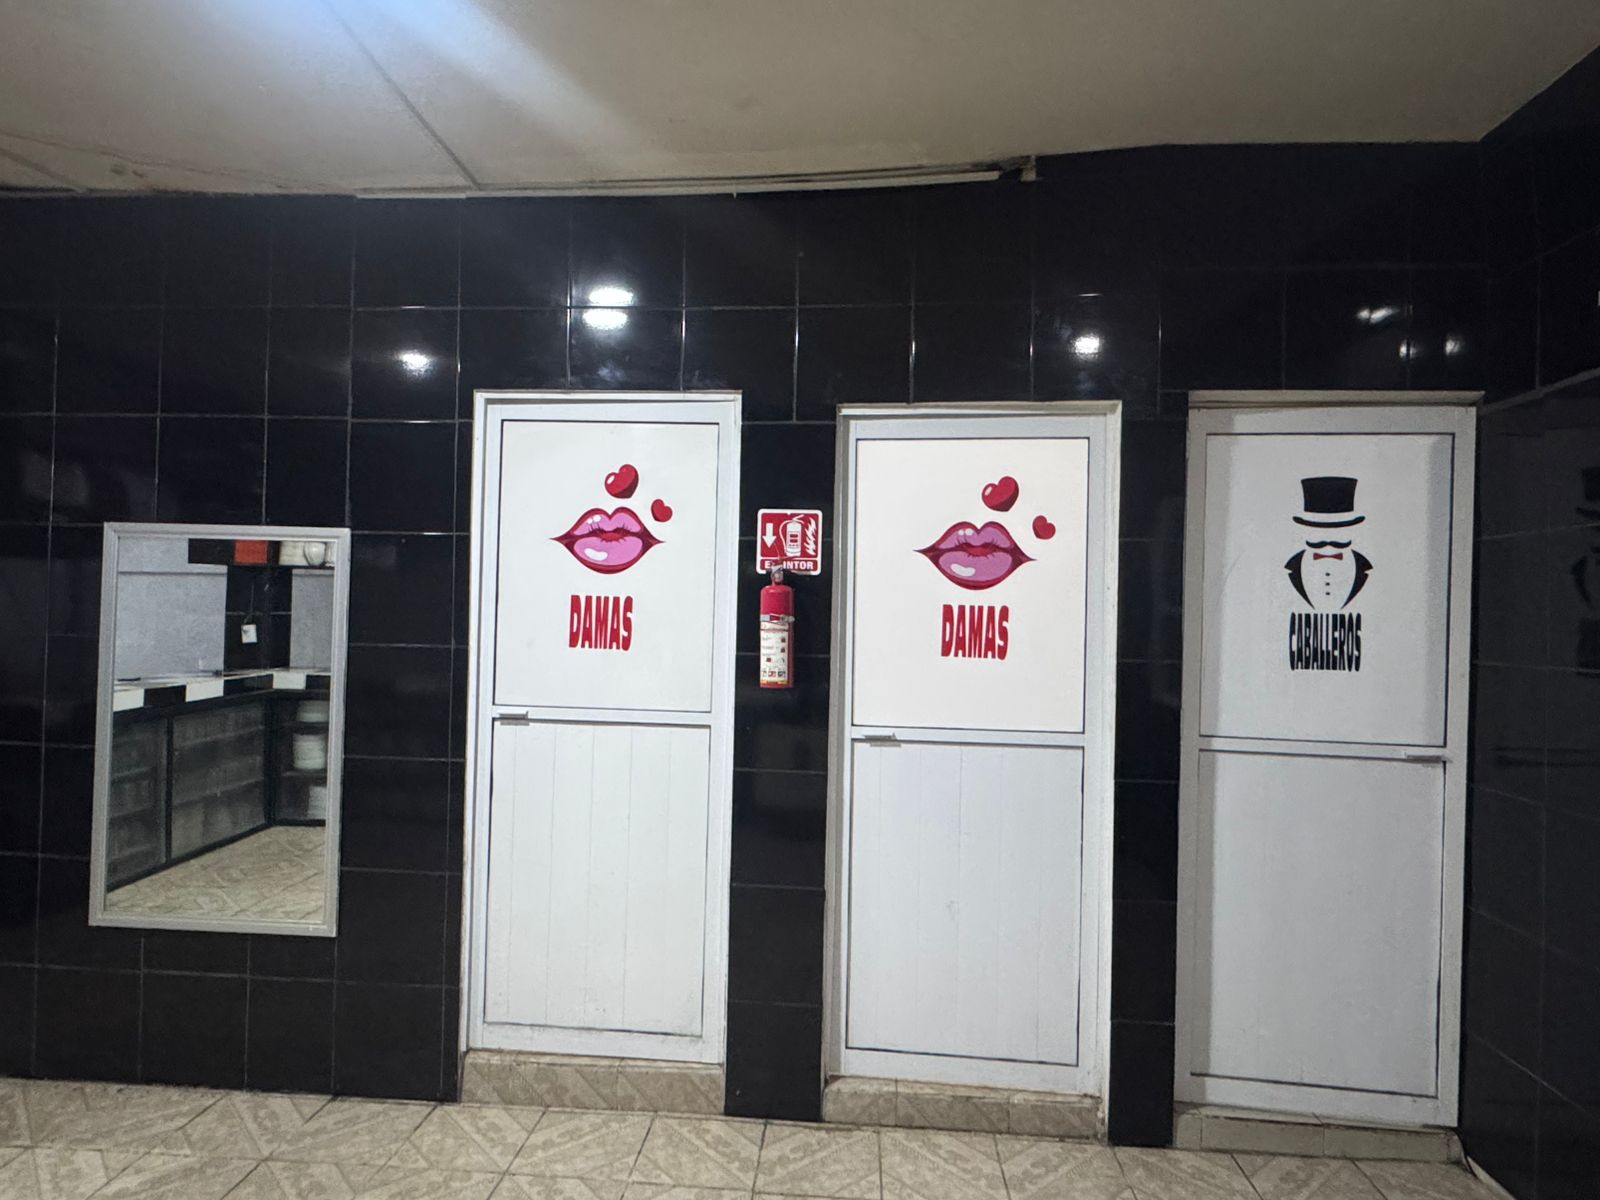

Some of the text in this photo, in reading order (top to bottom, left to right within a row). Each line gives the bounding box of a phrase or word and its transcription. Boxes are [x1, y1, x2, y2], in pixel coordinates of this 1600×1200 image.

[764, 560, 814, 570] EINTOR
[569, 595, 633, 651] DAMAS
[941, 604, 1009, 660] DAMAS
[1289, 612, 1361, 672] CABALLEROS
